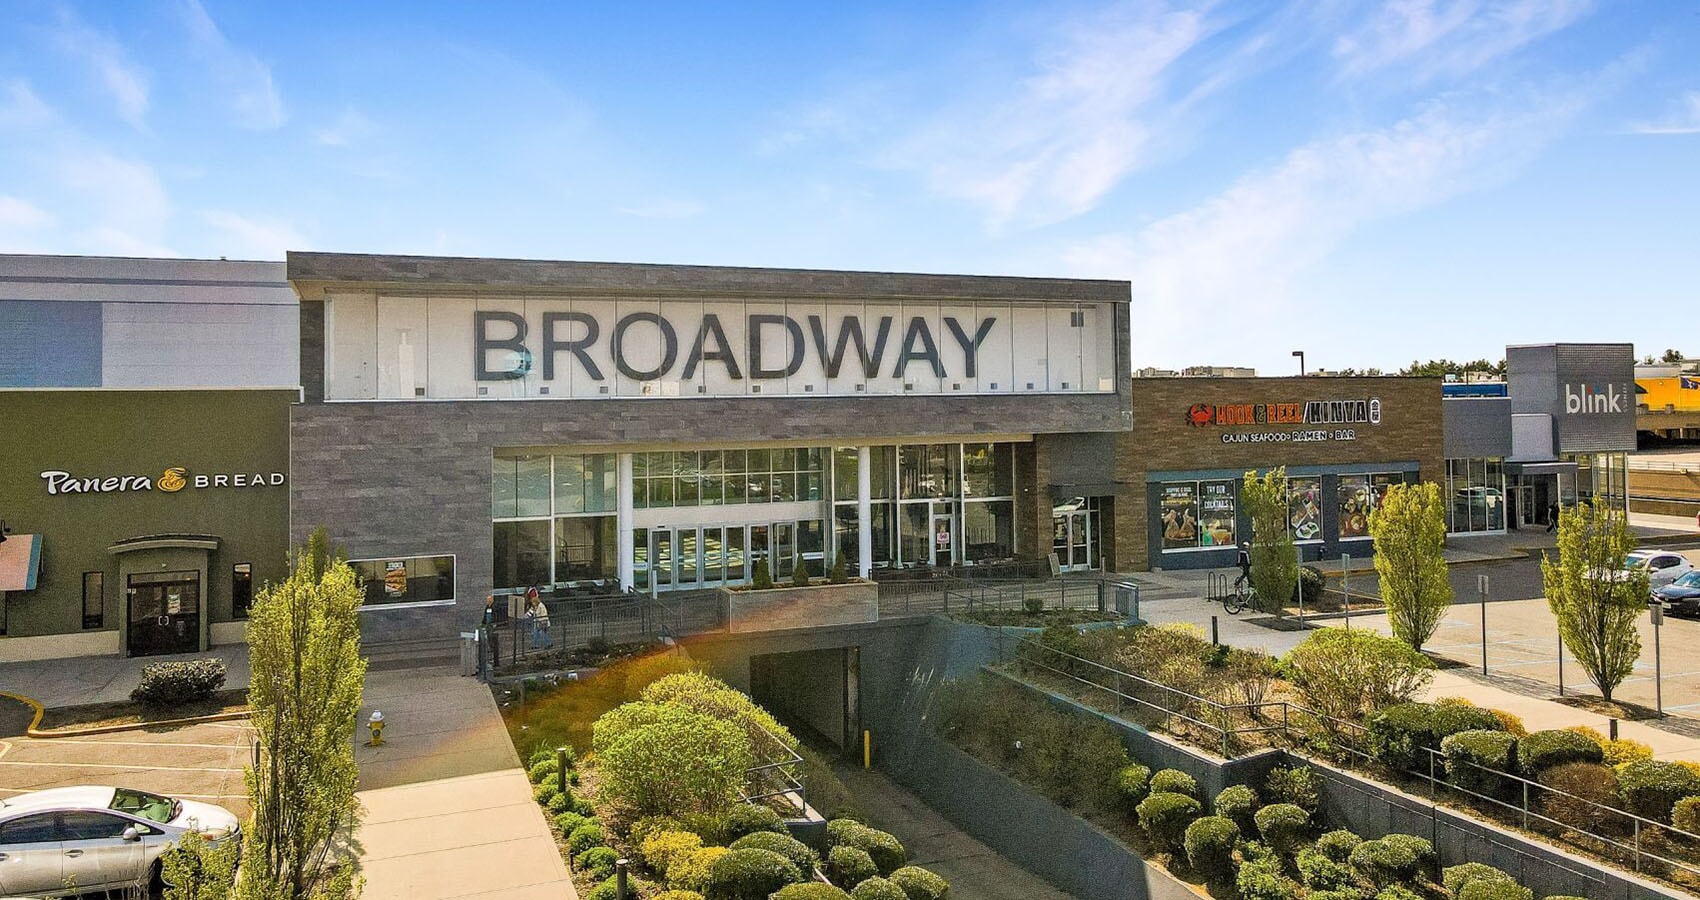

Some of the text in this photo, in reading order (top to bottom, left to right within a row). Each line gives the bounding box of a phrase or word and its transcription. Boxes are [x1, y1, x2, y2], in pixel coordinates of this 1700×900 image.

[473, 309, 997, 381] BROADWAY
[1566, 384, 1622, 413] blink
[1216, 404, 1256, 425] HOOK
[1266, 403, 1303, 424] REEL
[1222, 429, 1356, 443] CAJUN SEAFOOD RAMEN BAR
[40, 470, 285, 495] Panera BREAD
